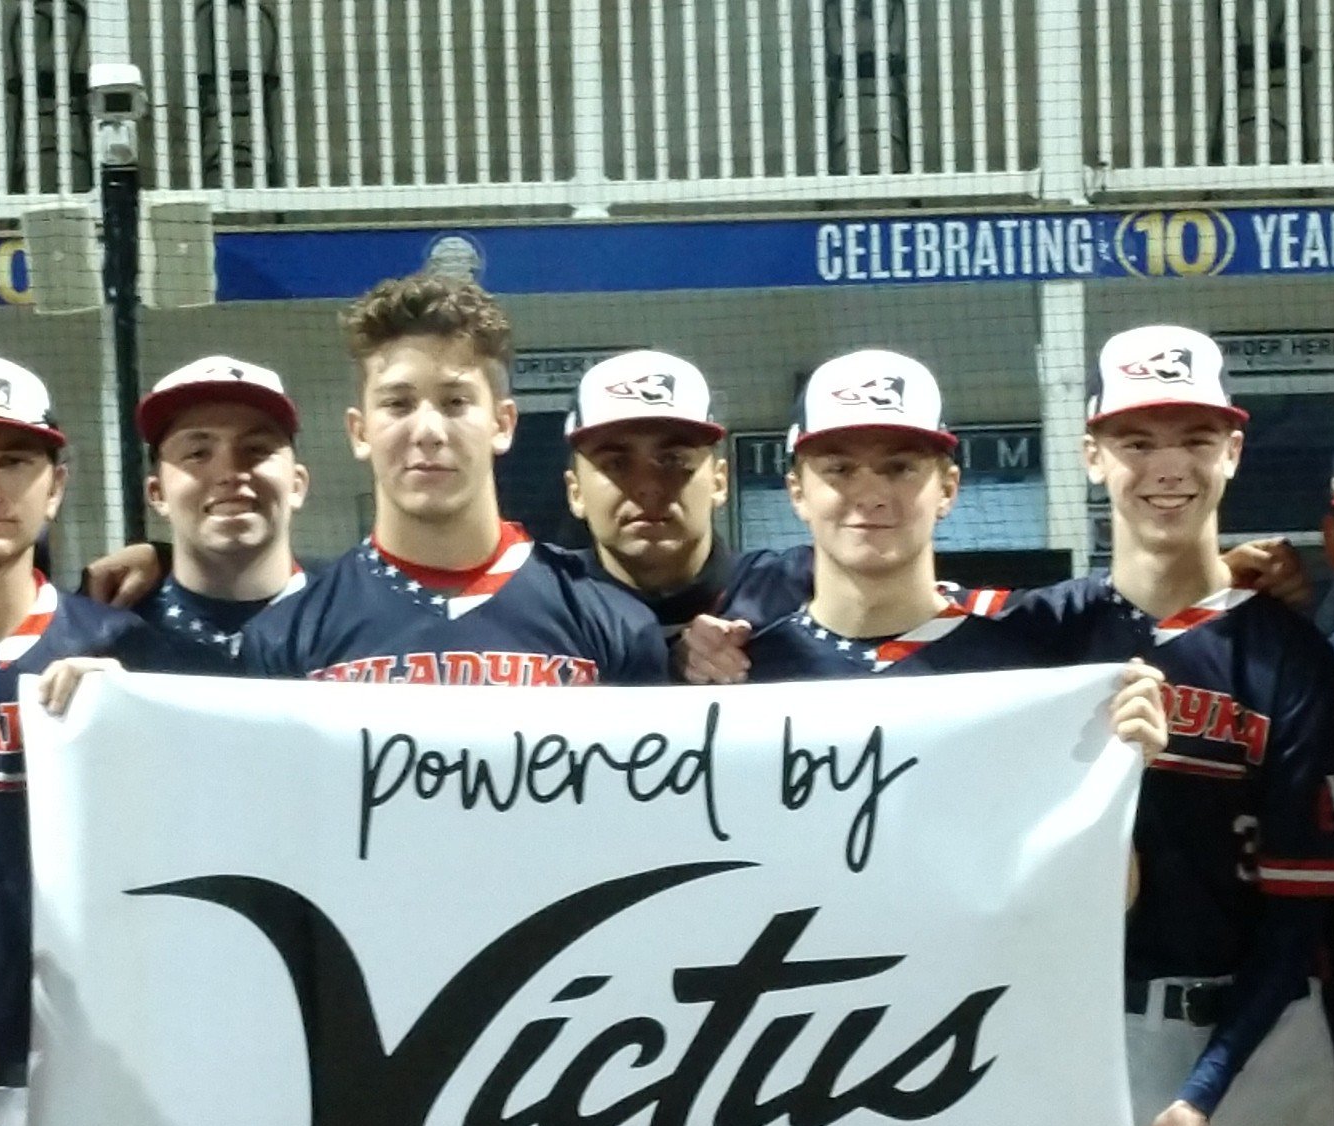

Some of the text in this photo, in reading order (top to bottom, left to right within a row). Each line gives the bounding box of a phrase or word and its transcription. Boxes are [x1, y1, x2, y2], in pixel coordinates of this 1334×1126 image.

[816, 218, 1093, 281] CELEBRATING
[1133, 209, 1219, 276] 10
[358, 701, 918, 872] powered by
